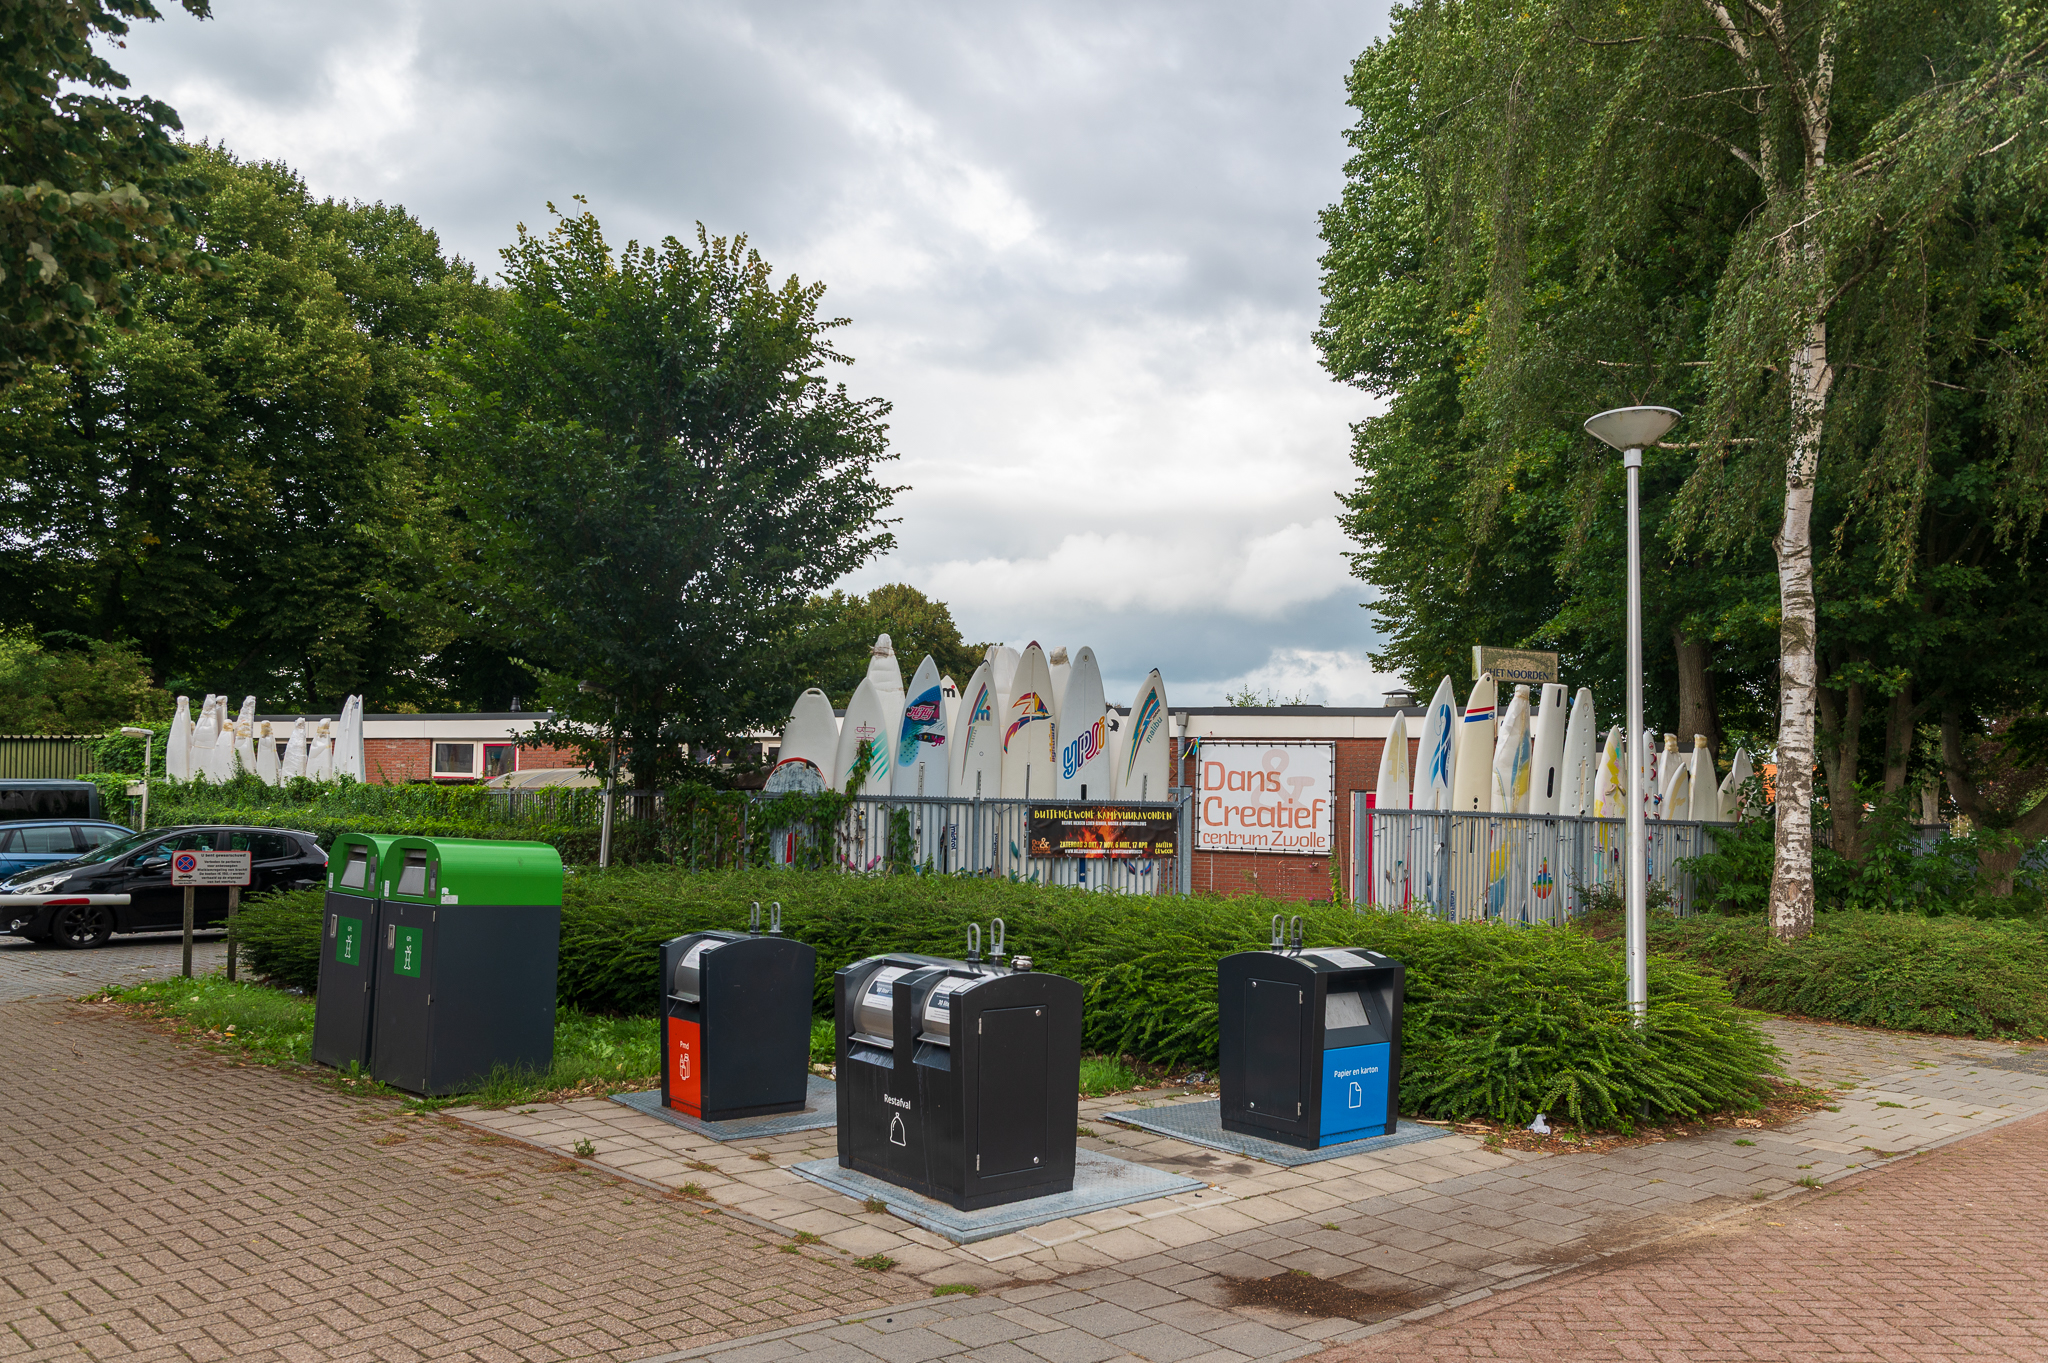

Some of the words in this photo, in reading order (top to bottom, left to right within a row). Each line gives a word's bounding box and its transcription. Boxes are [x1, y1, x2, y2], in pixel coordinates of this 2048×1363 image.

[1146, 716, 1162, 744] malibu
[1204, 762, 1281, 792] Dans
[1034, 810, 1094, 820] BUITENGEWONE
[1098, 810, 1172, 820] KAMPVUURAVONDEN
[1203, 796, 1326, 829] Creatief
[1202, 831, 1268, 846] centrum
[1271, 830, 1326, 848] Zwolle
[680, 1040, 689, 1050] Pmd
[1334, 1069, 1352, 1079] Papier
[1360, 1066, 1379, 1074] karton
[884, 1094, 911, 1110] Restafval
